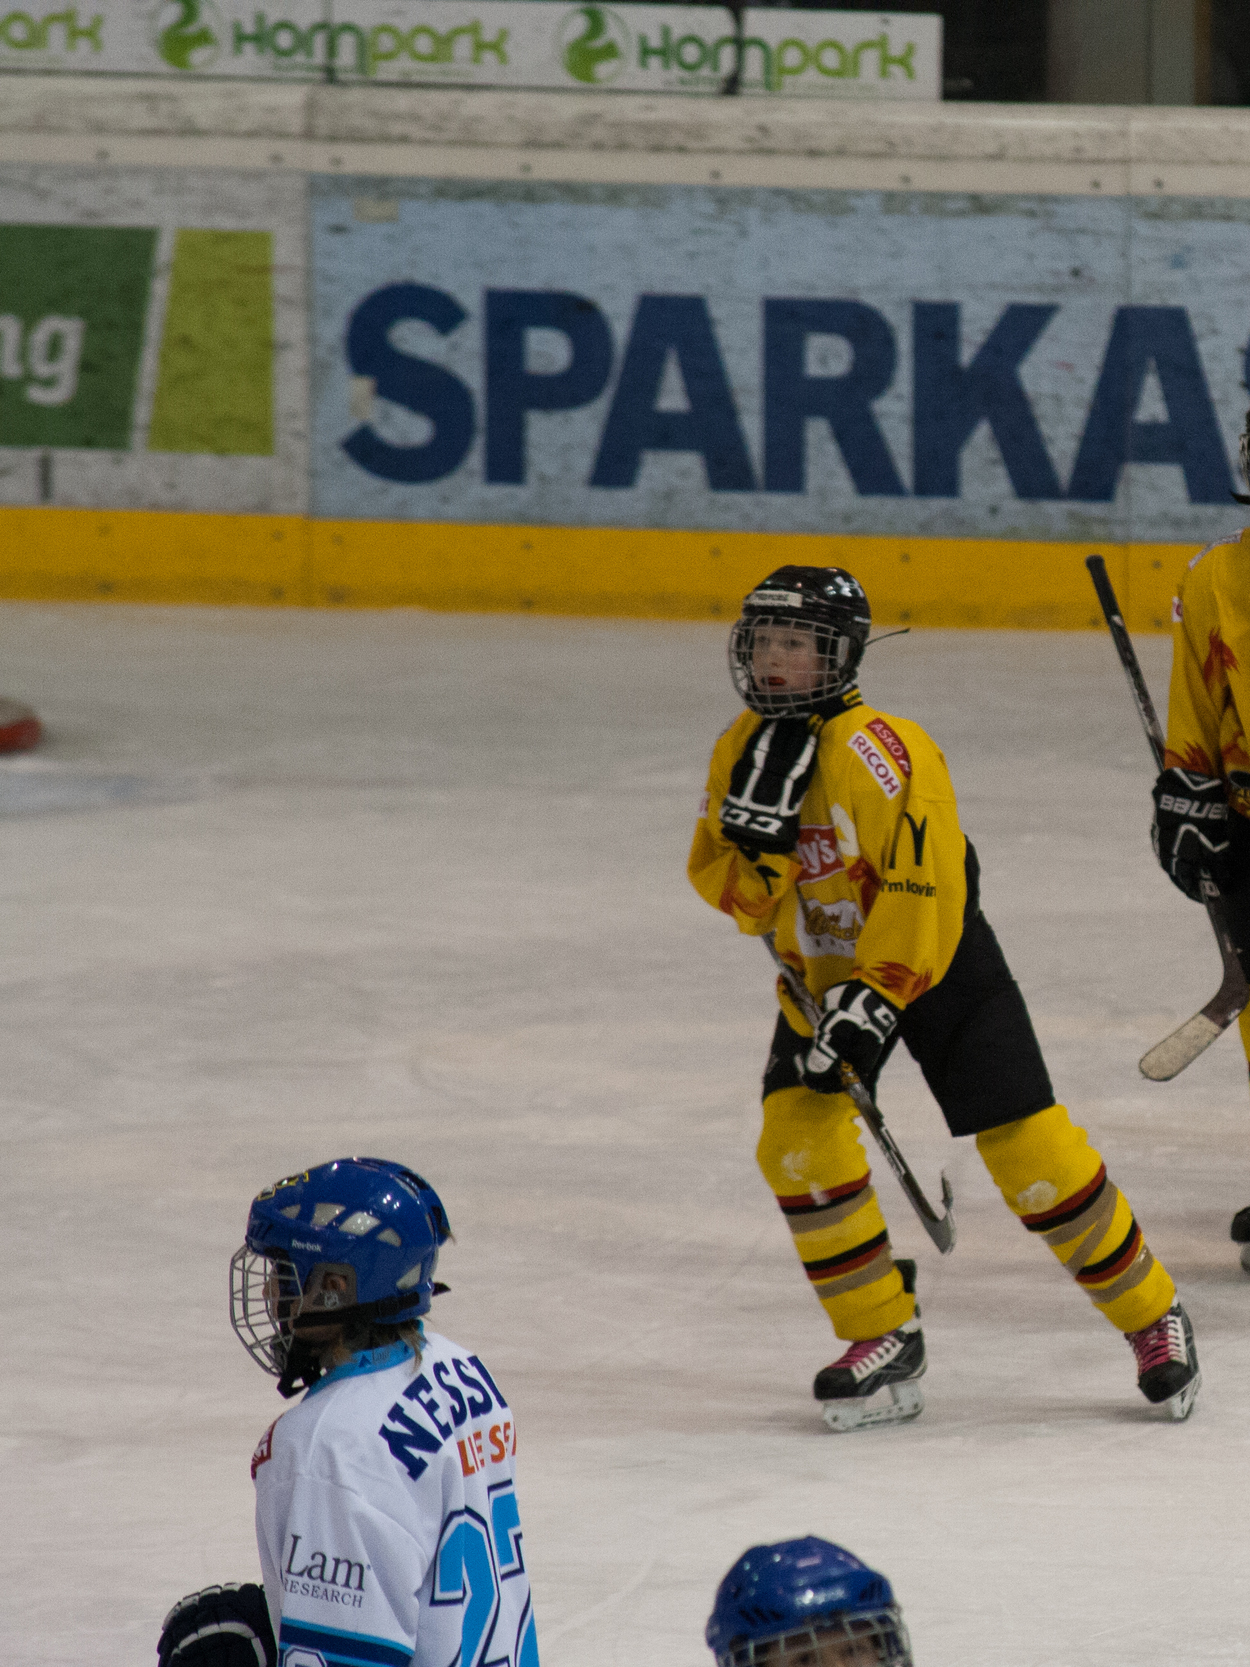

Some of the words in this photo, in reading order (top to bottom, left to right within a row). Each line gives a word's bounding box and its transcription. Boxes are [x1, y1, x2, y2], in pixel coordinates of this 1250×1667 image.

[852, 734, 899, 795] RICOH
[871, 722, 904, 757] ASKO
[284, 1534, 366, 1593] Lam
